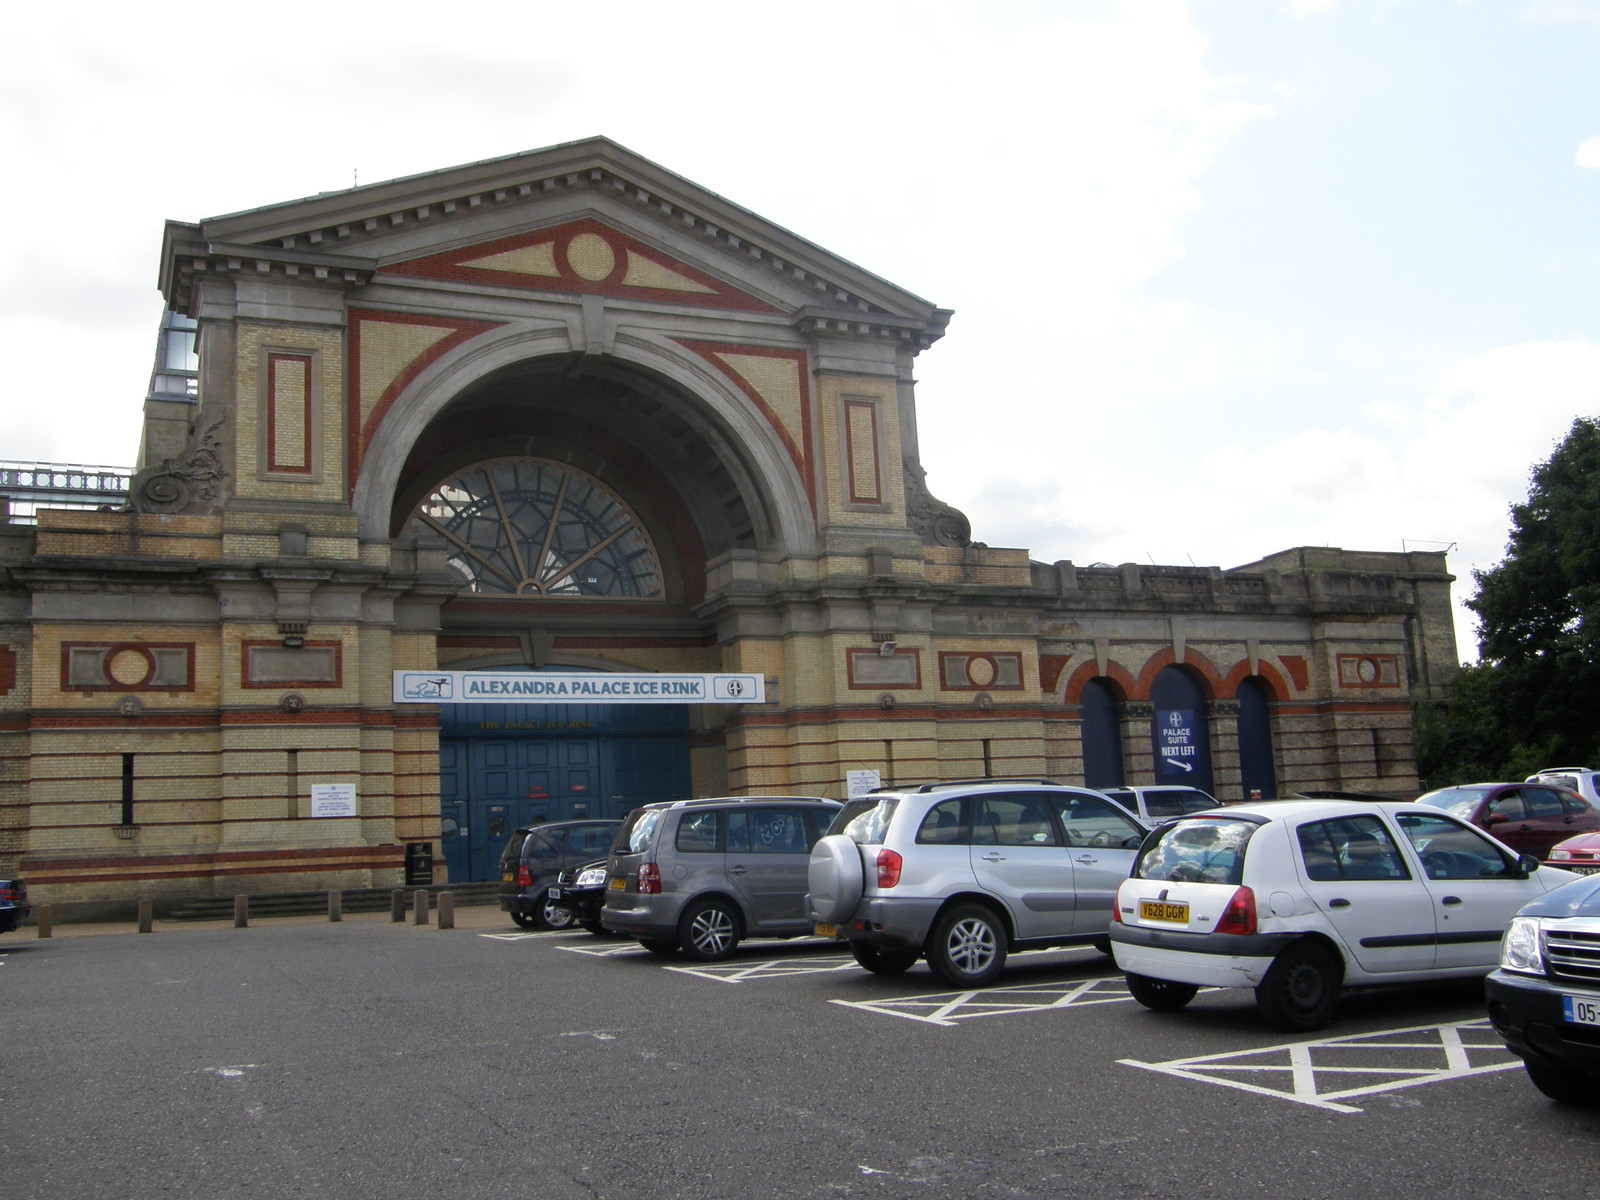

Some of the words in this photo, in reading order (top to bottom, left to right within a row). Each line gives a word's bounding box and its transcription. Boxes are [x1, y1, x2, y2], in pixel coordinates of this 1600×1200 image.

[469, 680, 568, 695] ALEXANDRA
[571, 681, 630, 695] PALACE
[633, 681, 658, 695] ICE
[661, 681, 701, 695] RINK
[480, 720, 500, 729] THE
[505, 720, 542, 729] PALACE
[546, 720, 562, 729] ICE
[1163, 728, 1191, 736] PALACE
[1167, 736, 1188, 744] SUITE
[1161, 746, 1180, 756] NEXT
[1180, 745, 1196, 756] LEFT
[1143, 903, 1164, 917] V628
[1165, 905, 1185, 919] GGR
